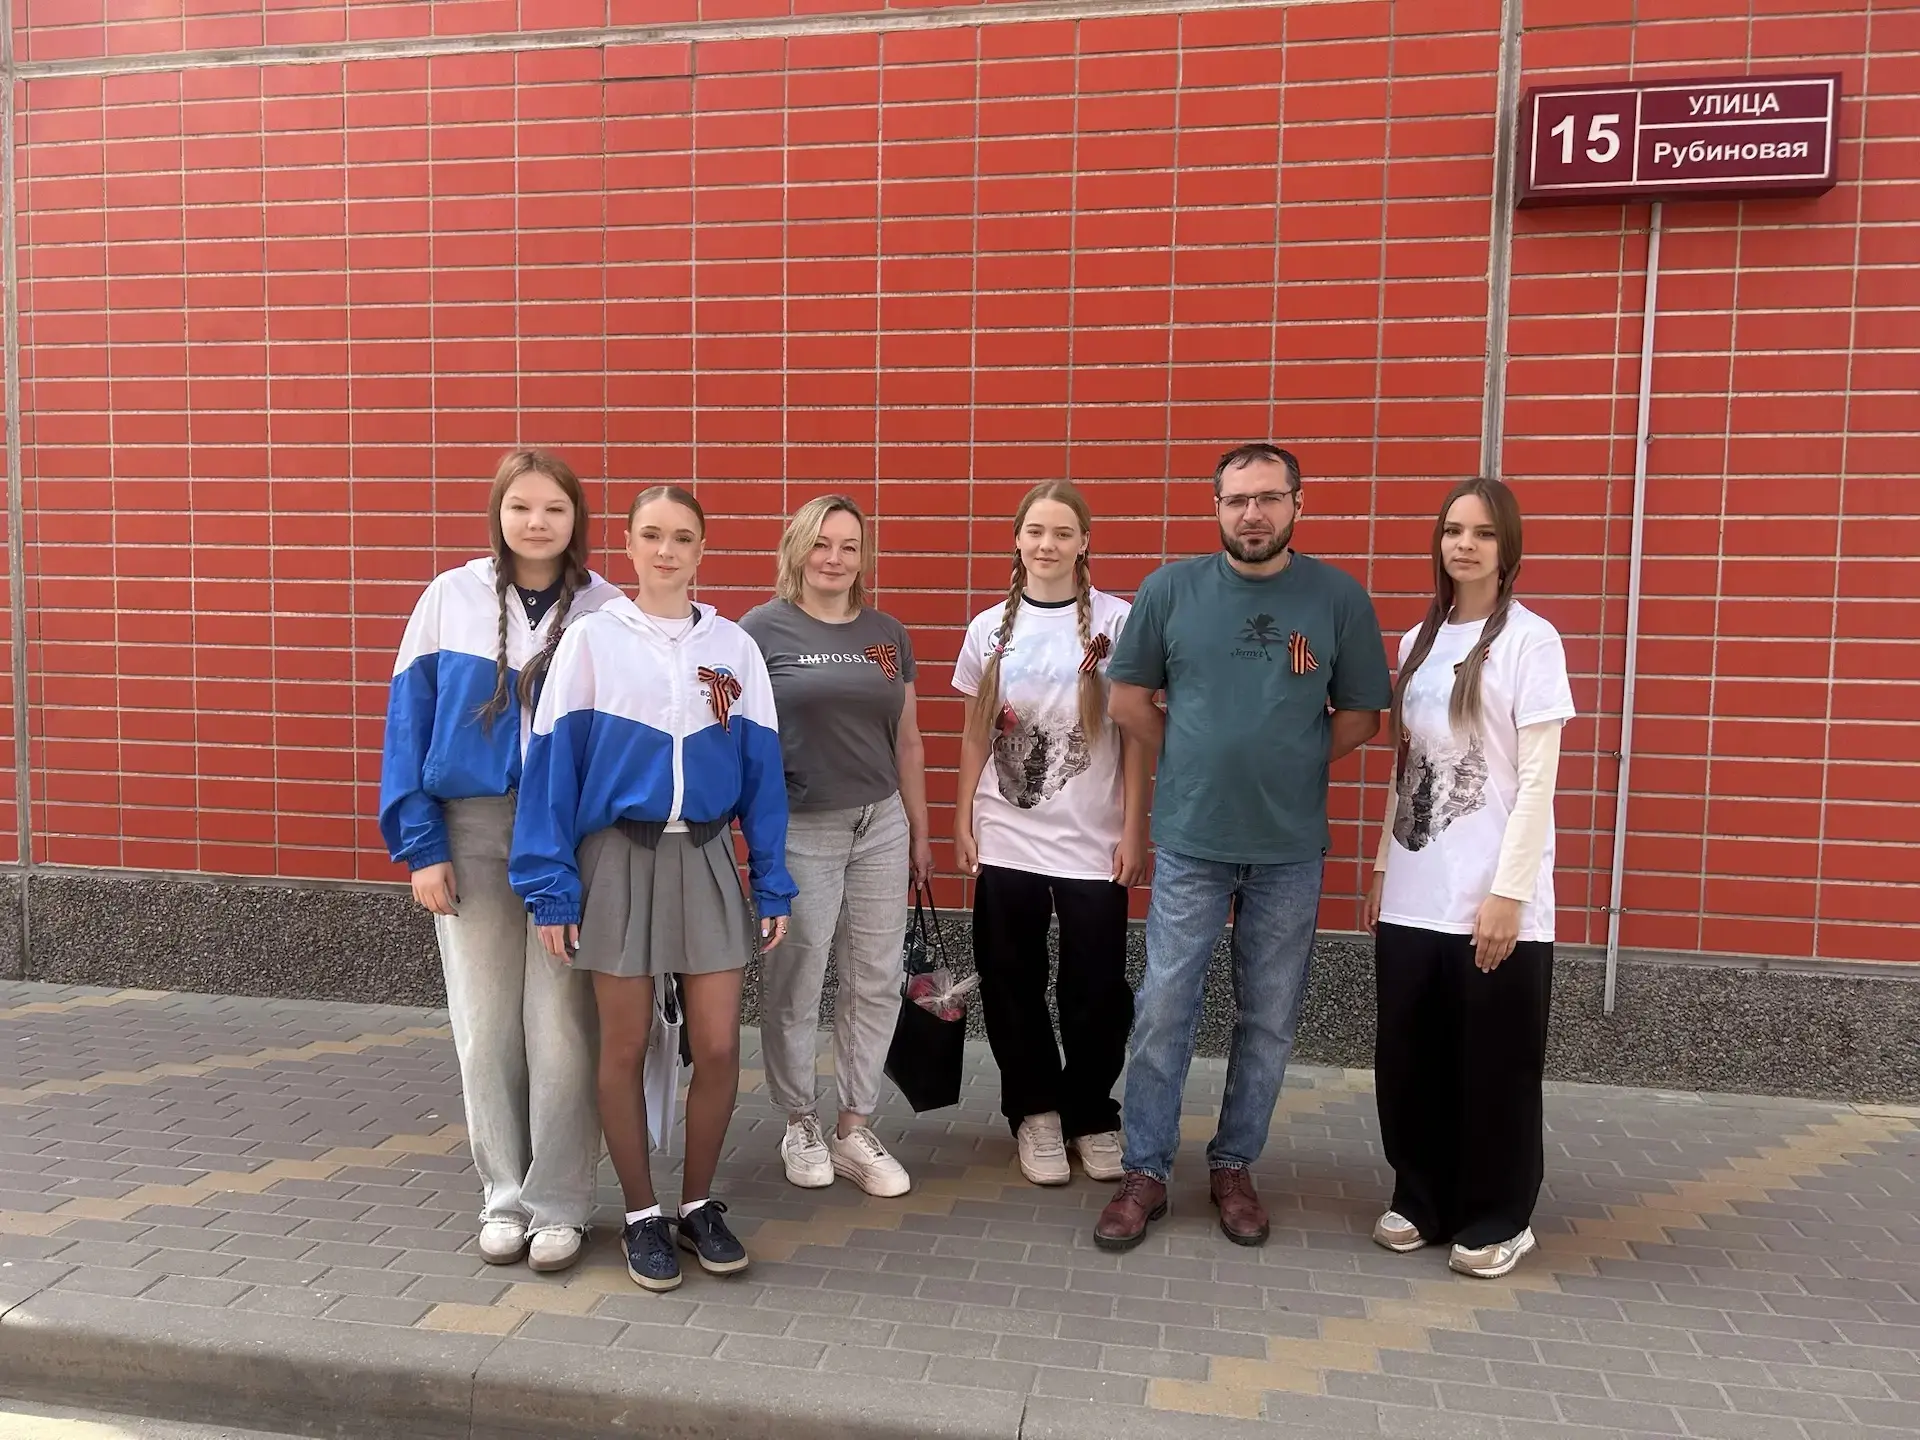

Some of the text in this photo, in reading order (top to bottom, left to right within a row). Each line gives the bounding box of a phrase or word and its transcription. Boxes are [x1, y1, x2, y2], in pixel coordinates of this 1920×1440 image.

[1689, 93, 1780, 117] УЛИЦА
[1550, 114, 1621, 165] 15
[1653, 140, 1808, 168] Рубиновая
